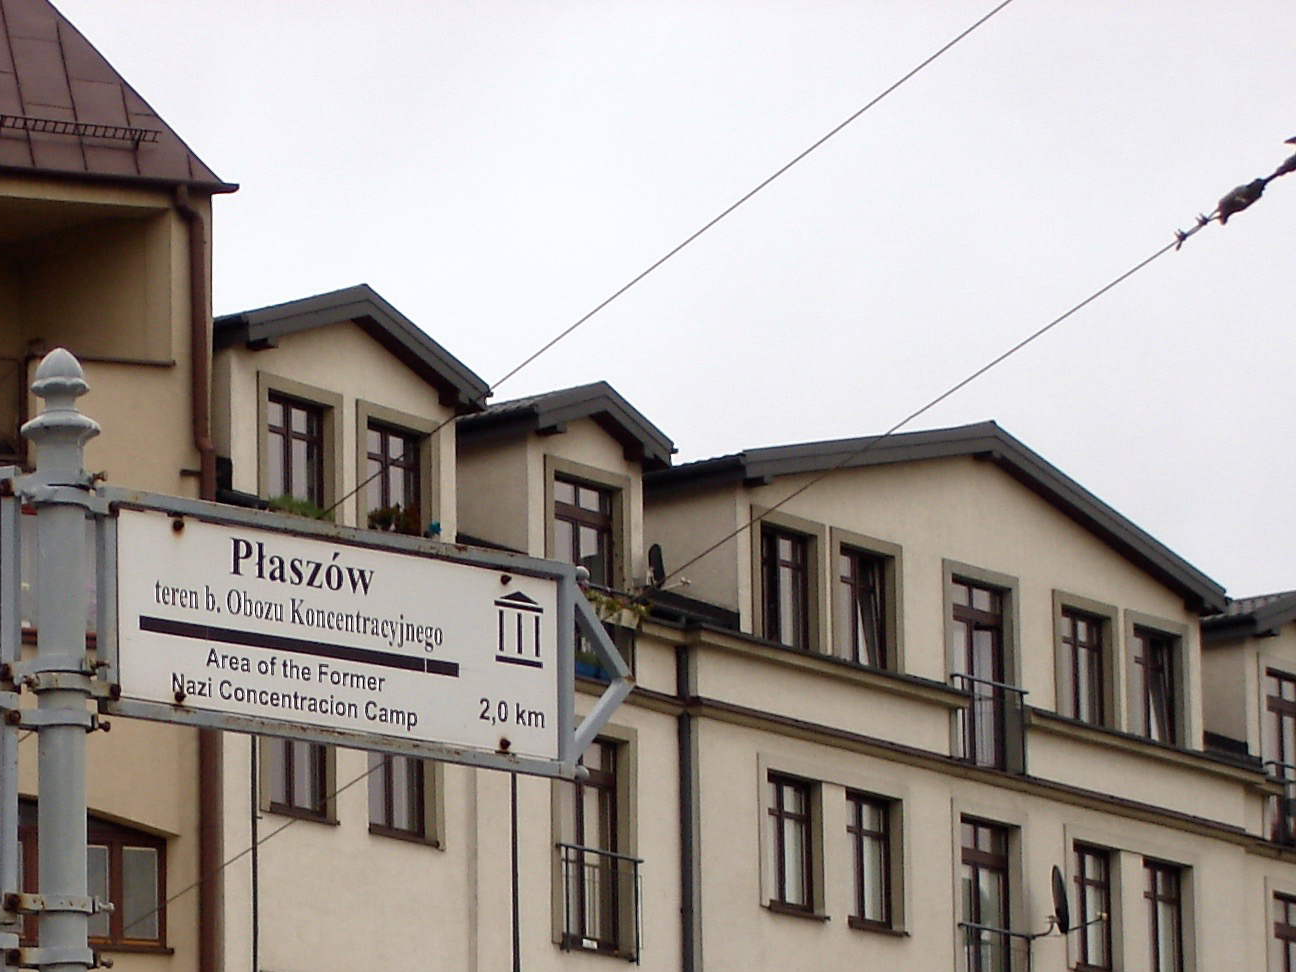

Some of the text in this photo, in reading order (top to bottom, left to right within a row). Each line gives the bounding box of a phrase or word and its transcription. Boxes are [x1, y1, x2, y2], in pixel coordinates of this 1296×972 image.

[232, 538, 373, 595] Płaszów
[154, 580, 442, 652] teren b. Obozu Koncentracyjnego
[207, 648, 385, 691] Area of the Former
[172, 673, 417, 731] Nazi Concentracion Camp
[480, 698, 544, 728] 2,0 km
